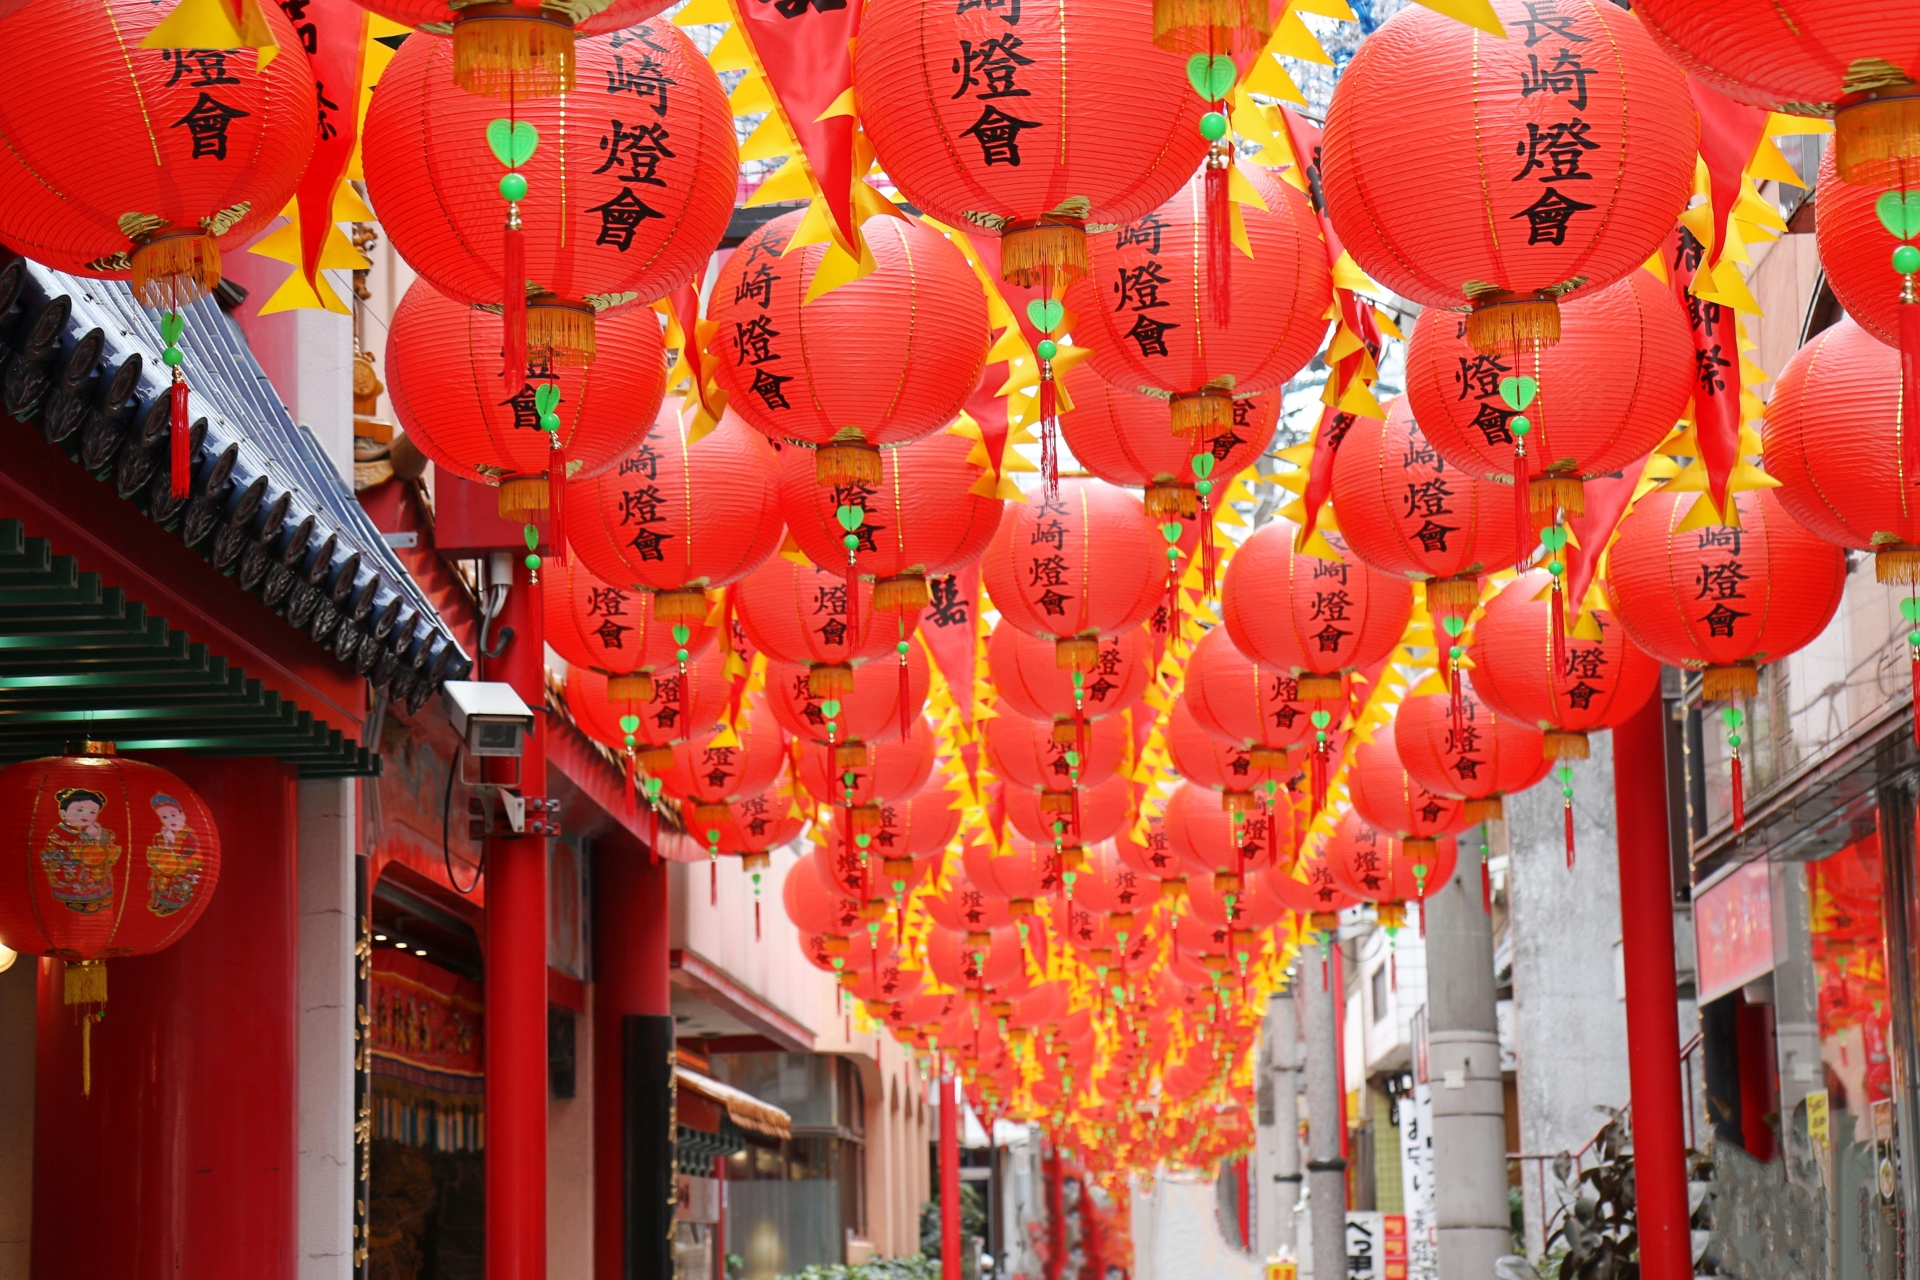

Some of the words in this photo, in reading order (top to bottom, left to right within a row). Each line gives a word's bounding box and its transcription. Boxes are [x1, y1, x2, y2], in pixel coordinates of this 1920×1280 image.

[1509, 0, 1601, 246] 長崎燈會
[733, 225, 794, 411] 長崎燈會
[1455, 312, 1523, 446] 燈會
[618, 424, 675, 562] 崎燈會
[587, 587, 634, 649] 燈會
[1695, 497, 1751, 638] 崎燈會
[650, 676, 680, 728] 燈會
[1085, 636, 1122, 702] 燈會
[701, 748, 735, 788] 燈會
[1445, 680, 1487, 781] 崎燈會
